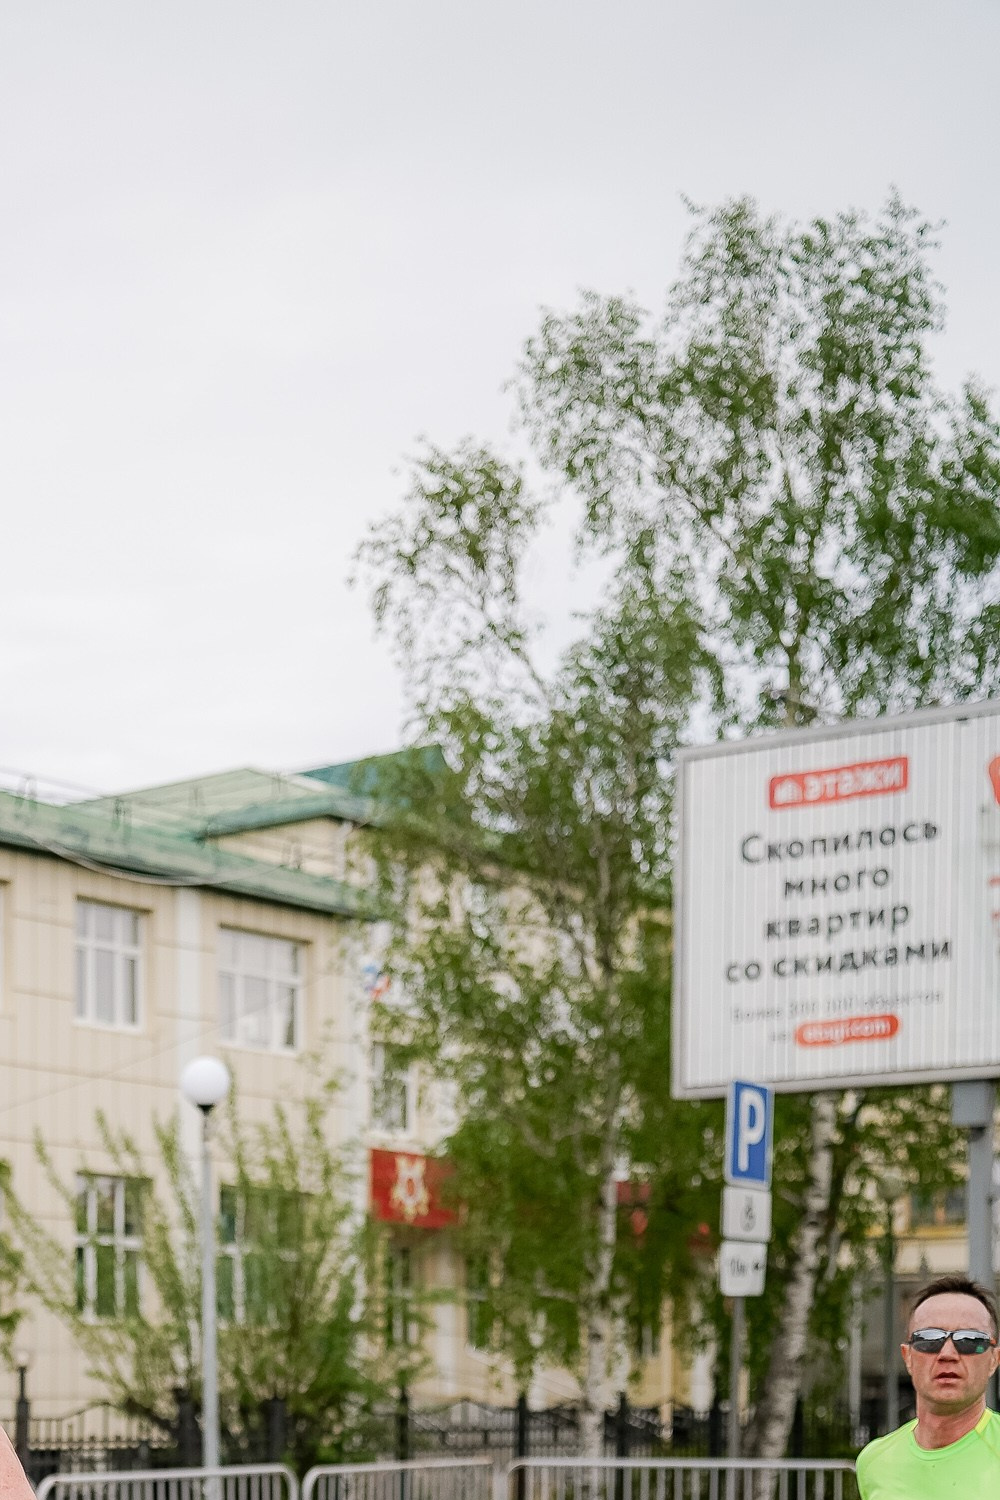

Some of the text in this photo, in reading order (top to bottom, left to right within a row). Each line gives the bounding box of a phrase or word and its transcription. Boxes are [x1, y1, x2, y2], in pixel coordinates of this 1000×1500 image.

[741, 822, 938, 864] Скопилось
[784, 867, 889, 899] много
[766, 904, 909, 942] квартир
[726, 941, 949, 983] со скидками
[738, 1090, 766, 1172] P
